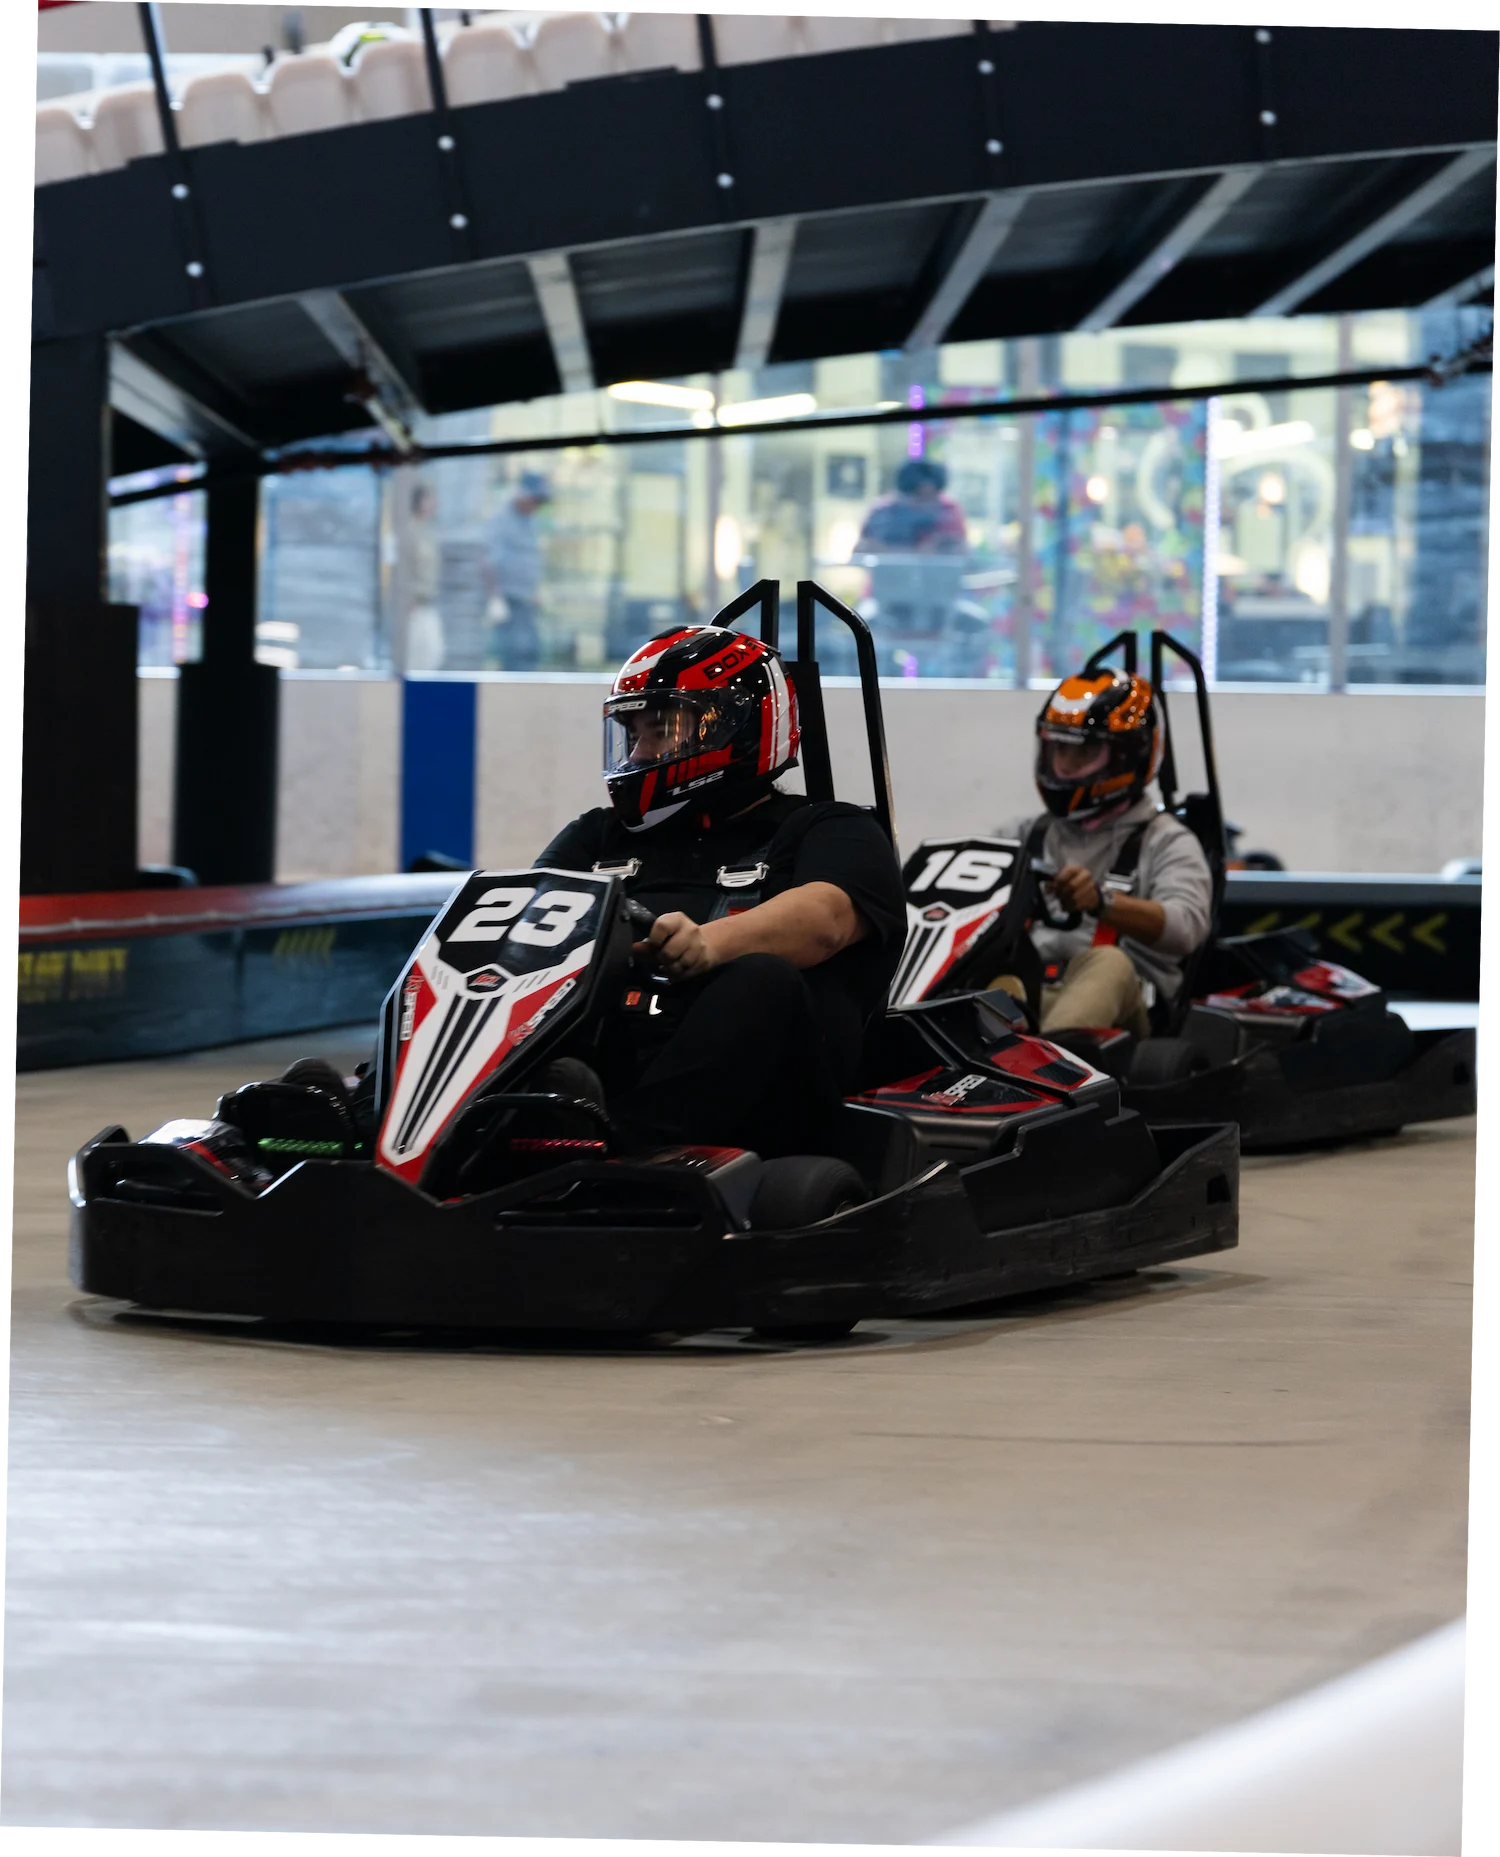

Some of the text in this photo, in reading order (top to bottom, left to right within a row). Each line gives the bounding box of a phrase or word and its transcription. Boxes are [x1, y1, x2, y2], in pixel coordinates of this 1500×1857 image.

[667, 769, 725, 797] LS2
[908, 849, 1015, 893] 16
[446, 886, 597, 948] 23
